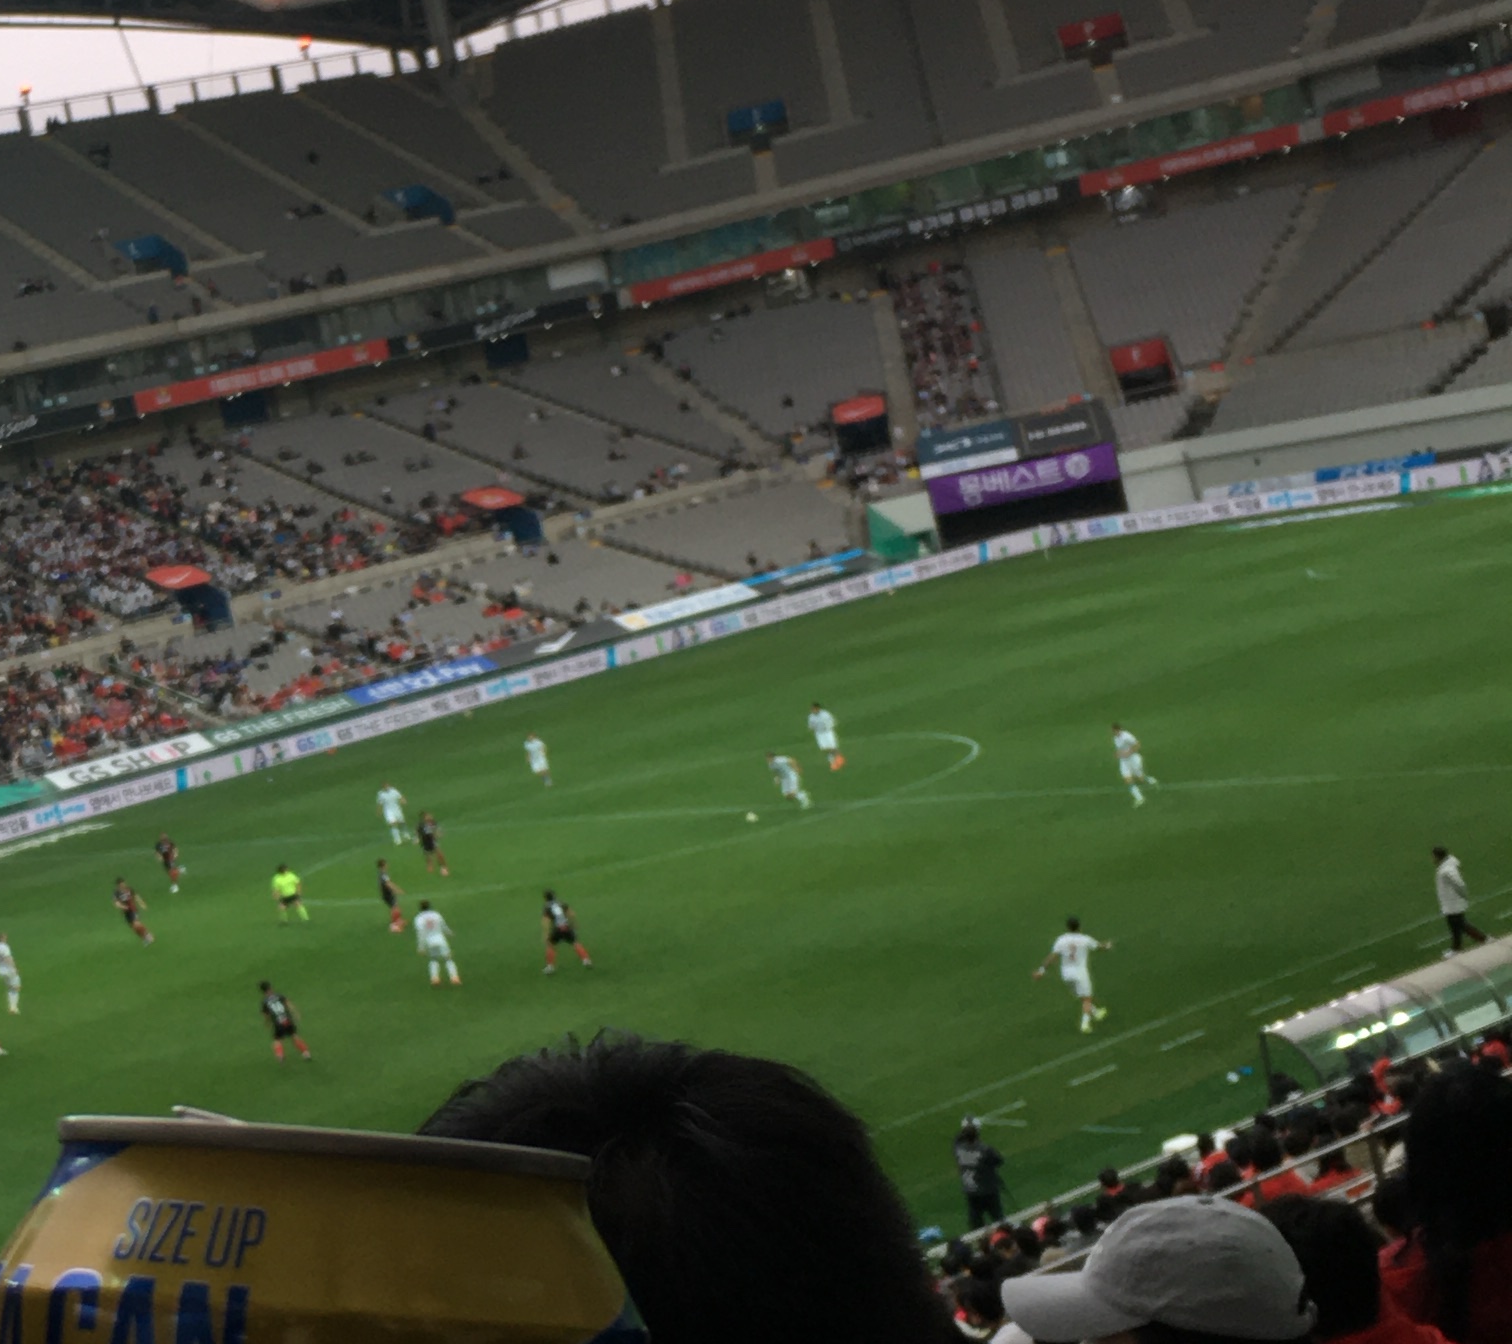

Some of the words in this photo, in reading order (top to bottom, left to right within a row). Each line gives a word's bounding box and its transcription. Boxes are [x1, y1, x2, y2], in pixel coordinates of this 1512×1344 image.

[213, 728, 240, 745] GS
[240, 716, 283, 736] THE
[282, 698, 352, 725] FRESH
[68, 764, 109, 786] GS
[110, 741, 194, 777] SHOP
[112, 1196, 205, 1265] SIZE
[204, 1205, 270, 1269] UP
